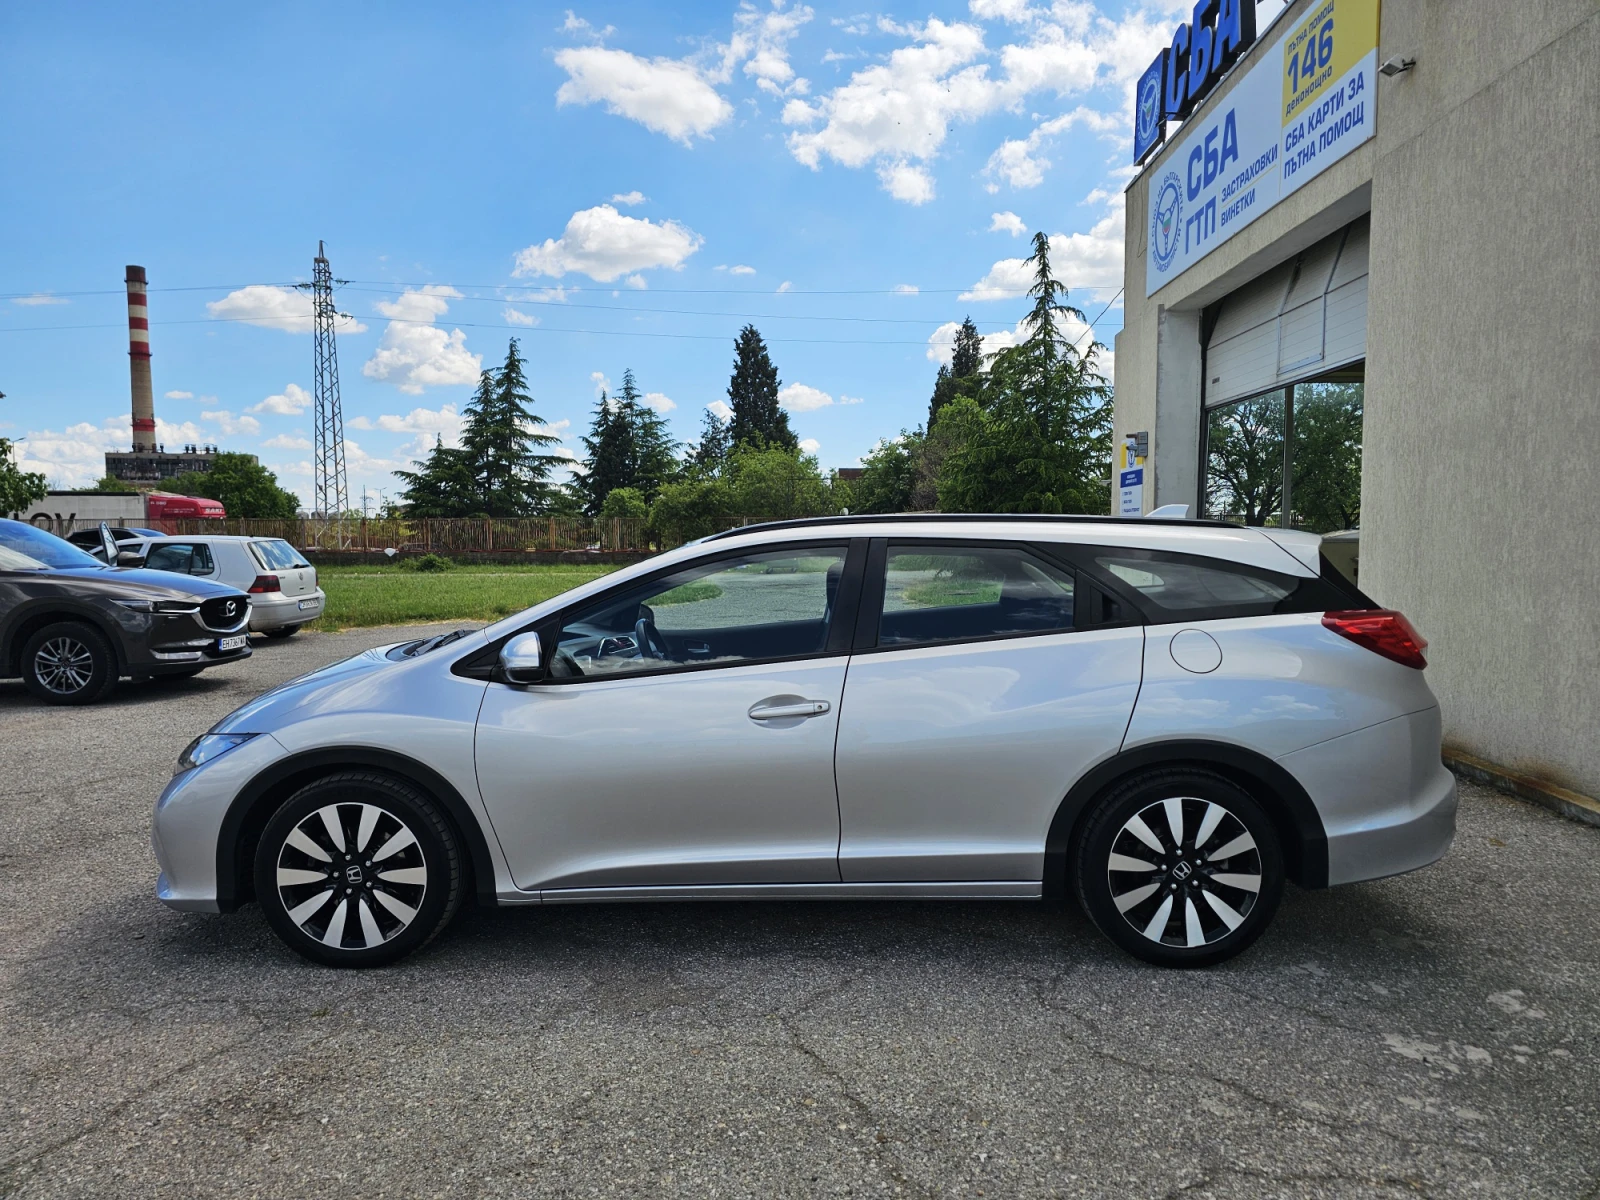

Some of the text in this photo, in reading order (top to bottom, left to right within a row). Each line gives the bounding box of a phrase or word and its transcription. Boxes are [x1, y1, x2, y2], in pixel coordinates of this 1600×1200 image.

[1165, 0, 1241, 119] СБА
[1287, 0, 1335, 56] ПЪТНА ПОМОЩ
[1287, 18, 1334, 95] 146
[1284, 101, 1365, 180] ПЪТНА ПОМОЩ
[1285, 71, 1365, 153] СБА КАРТИ ЗА
[1186, 107, 1239, 202] СБА
[1221, 143, 1278, 203] ЗАСТРАХОВКИ
[1185, 195, 1217, 255] ГТП
[1220, 188, 1256, 227] ВИНЕТКИ
